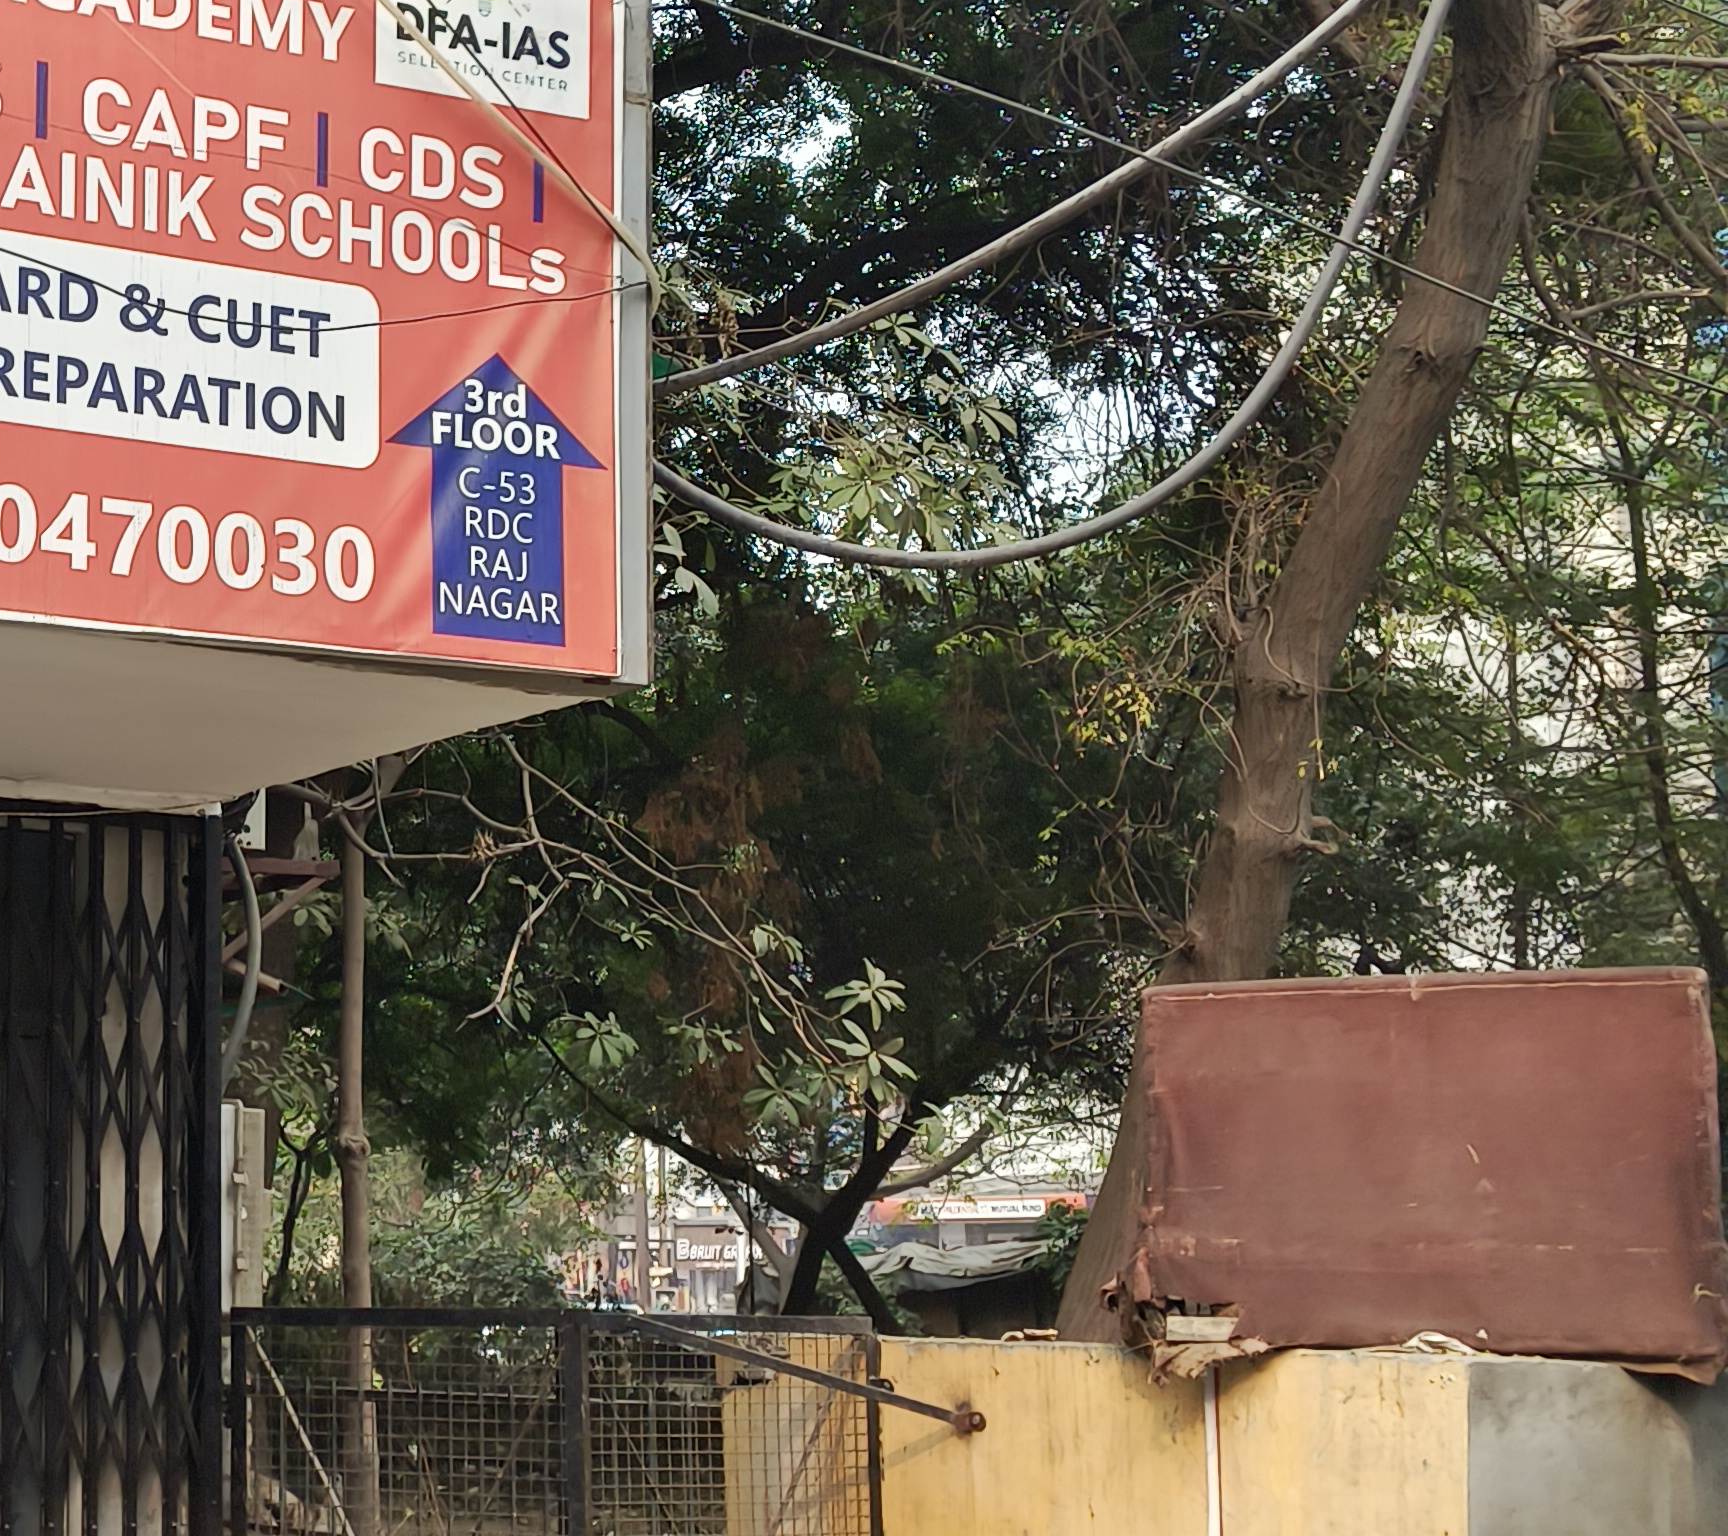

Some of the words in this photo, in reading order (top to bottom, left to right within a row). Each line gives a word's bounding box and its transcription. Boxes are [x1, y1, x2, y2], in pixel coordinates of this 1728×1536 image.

[397, 2, 570, 69] DFA-IAS
[397, 51, 494, 77] SELTIO
[502, 70, 568, 92] CENTER
[82, 77, 289, 170] CAPF
[360, 126, 504, 209] CDS
[119, 282, 168, 336] &
[189, 294, 331, 360] CUET
[464, 379, 527, 419] 3rd
[431, 410, 562, 460] FLOOR
[458, 467, 536, 505] C-53
[465, 506, 533, 544] RDC
[470, 545, 528, 582] RAJ
[438, 581, 561, 625] NAGAR
